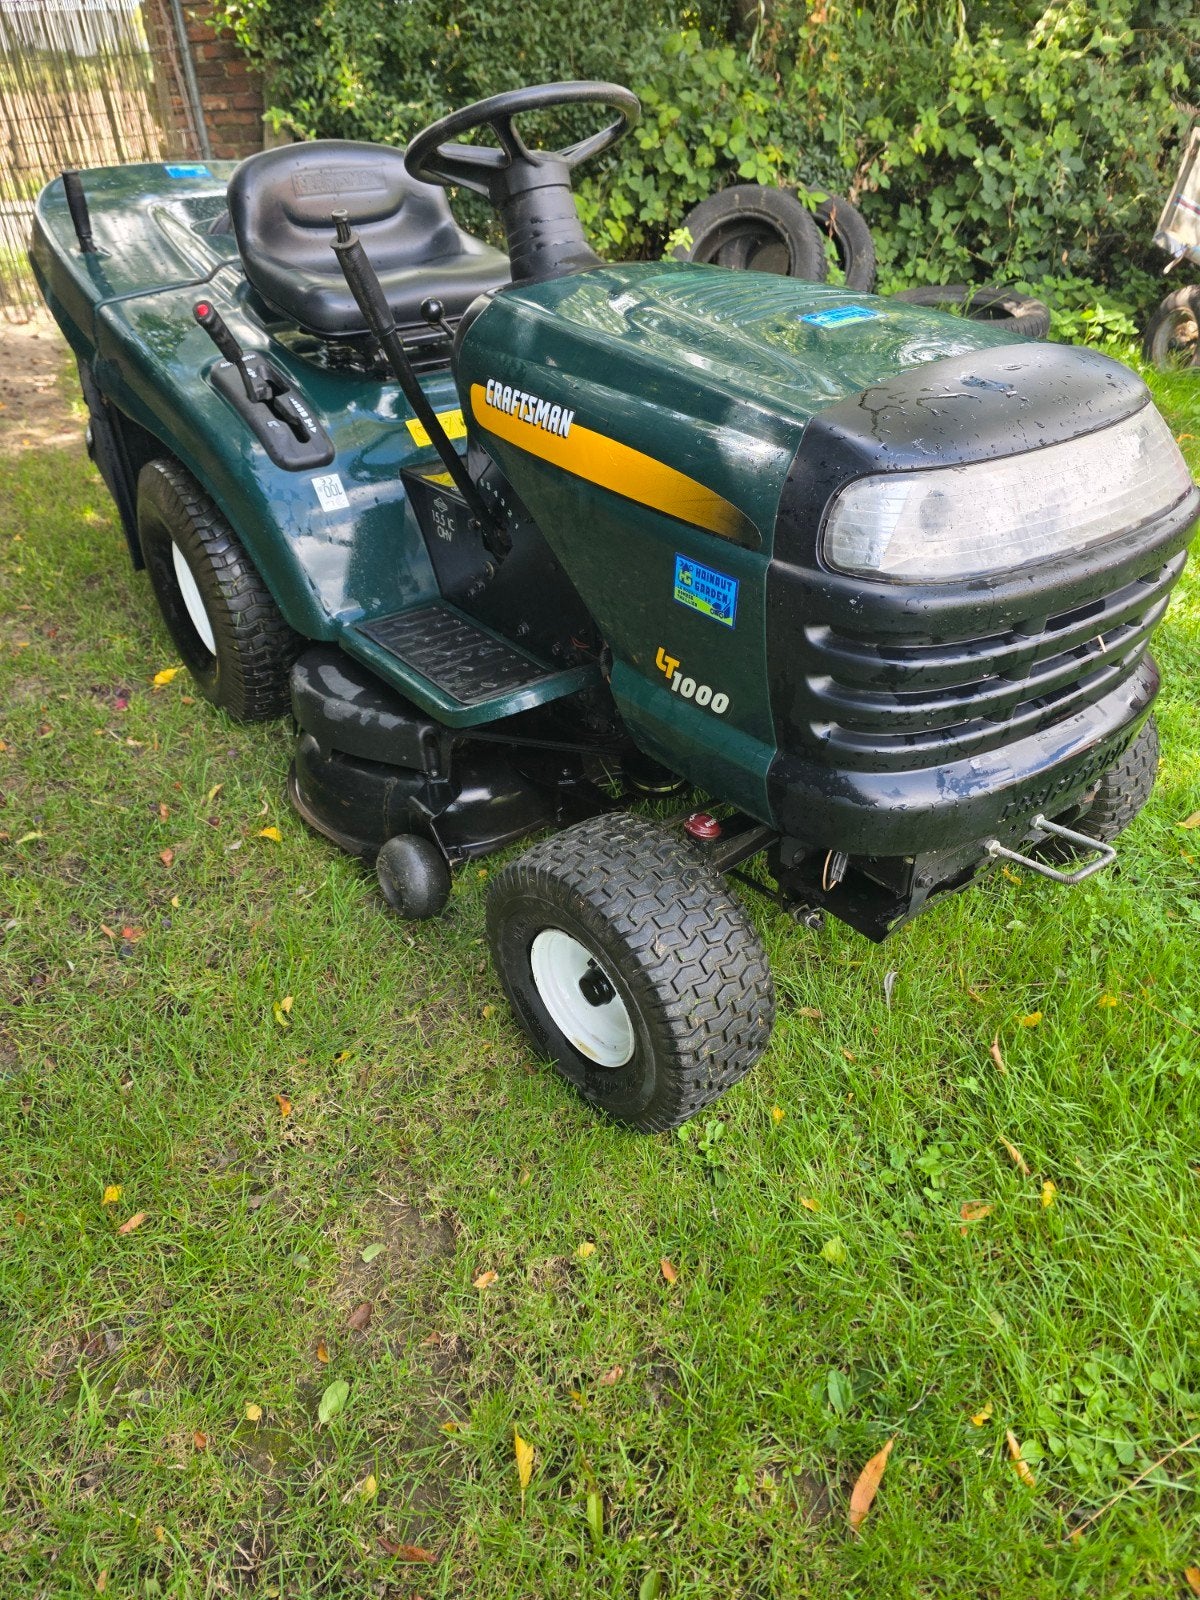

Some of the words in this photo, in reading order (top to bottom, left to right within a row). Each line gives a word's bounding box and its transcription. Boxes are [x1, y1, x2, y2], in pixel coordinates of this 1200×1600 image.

[486, 378, 575, 438] CRAFTSMAN
[694, 582, 728, 604] GARDEN
[655, 647, 680, 680] LT
[671, 671, 730, 714] 1000
